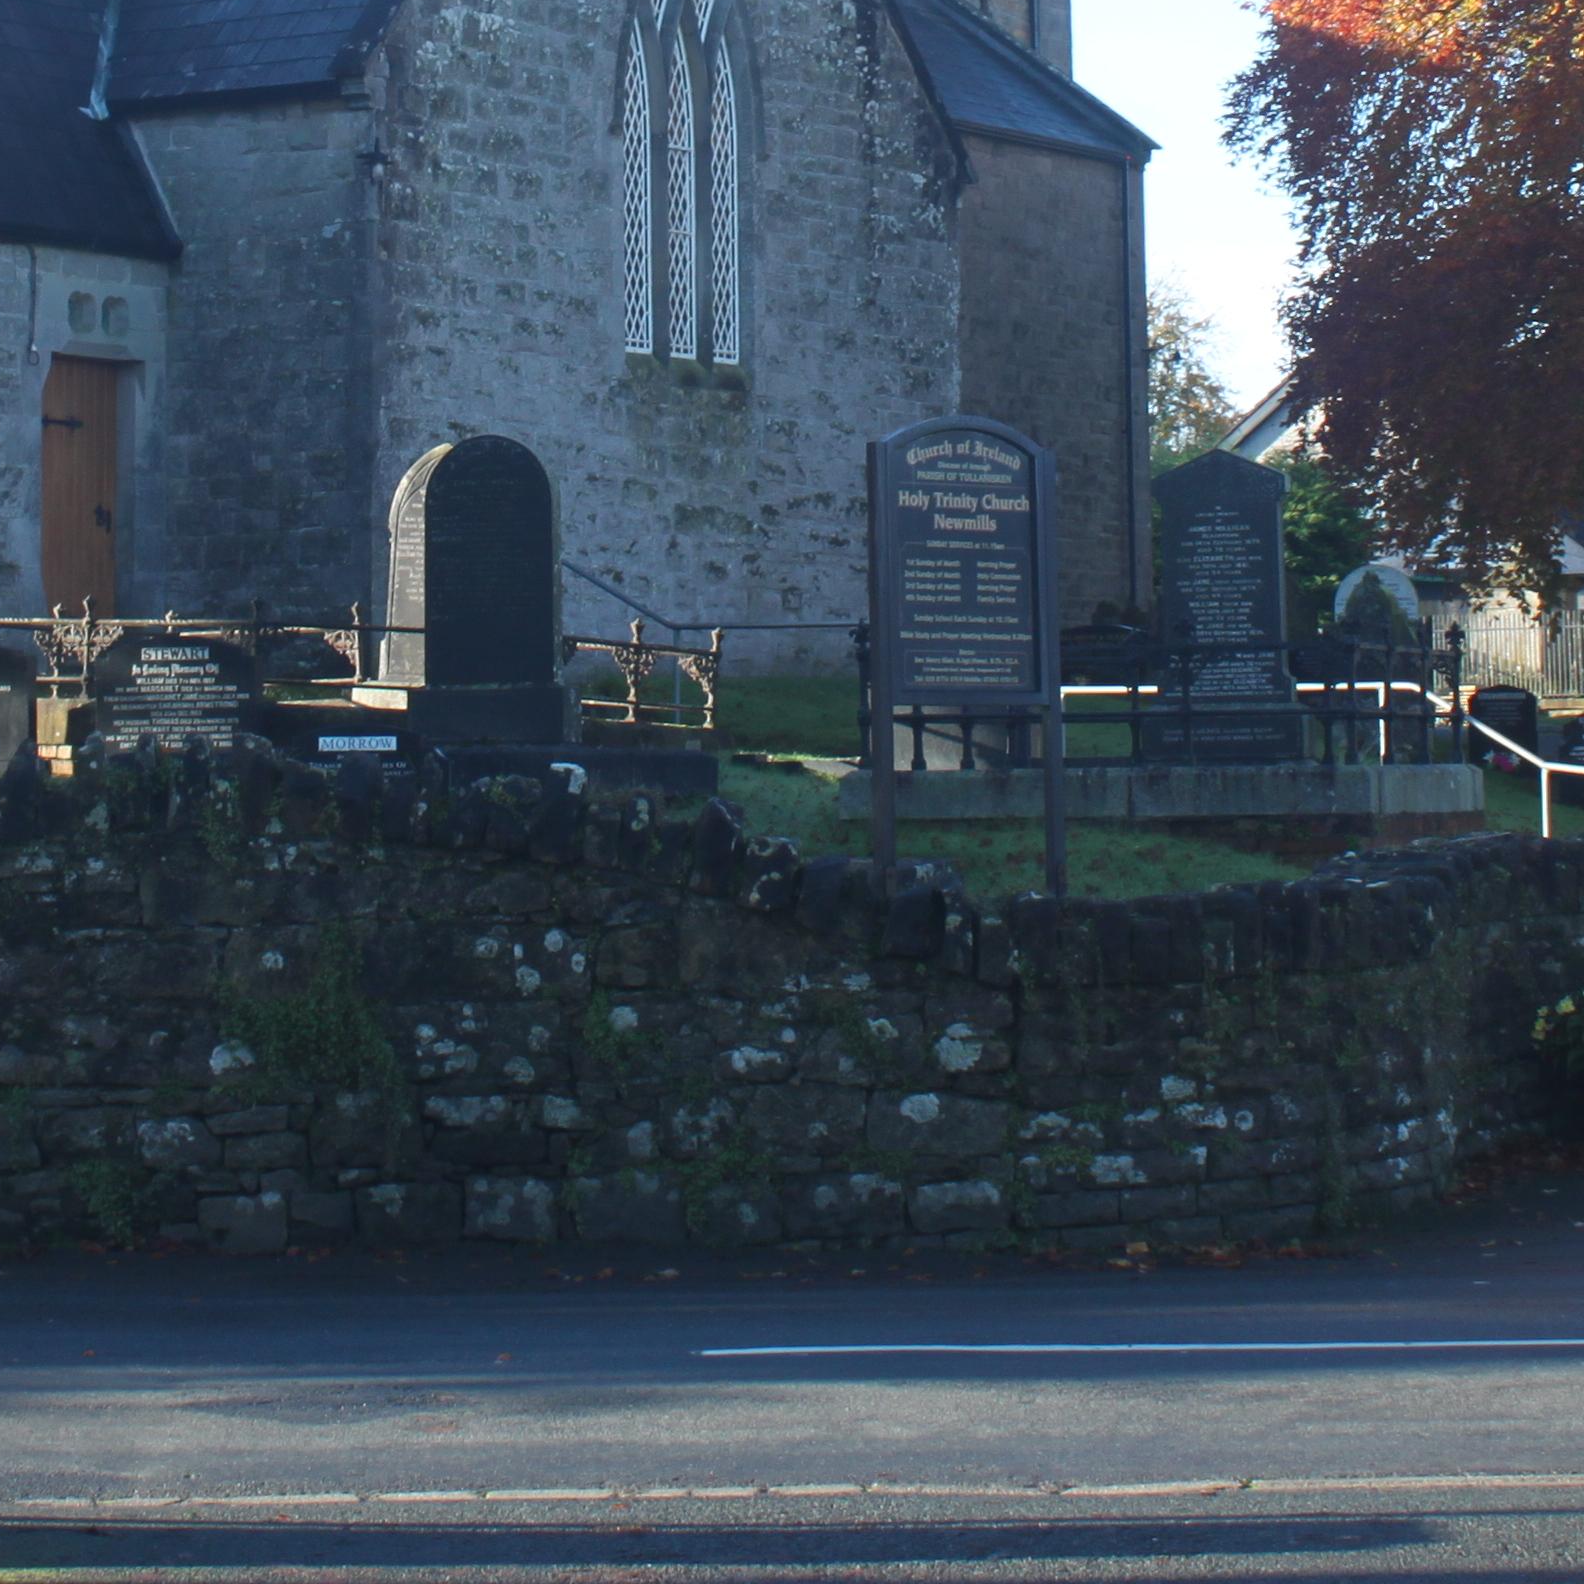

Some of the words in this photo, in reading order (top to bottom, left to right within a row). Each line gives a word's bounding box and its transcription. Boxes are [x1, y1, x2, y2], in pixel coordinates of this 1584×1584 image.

[906, 440, 953, 465] Church
[957, 440, 970, 454] of
[973, 440, 1021, 470] Ireland
[917, 471, 945, 480] PARISH
[946, 472, 959, 481] OF
[898, 489, 930, 511] Holy
[933, 491, 979, 513] Trinity
[982, 493, 1030, 511] Church
[933, 513, 997, 531] Newmills
[142, 648, 209, 661] STEWART
[321, 738, 393, 749] MORROW
